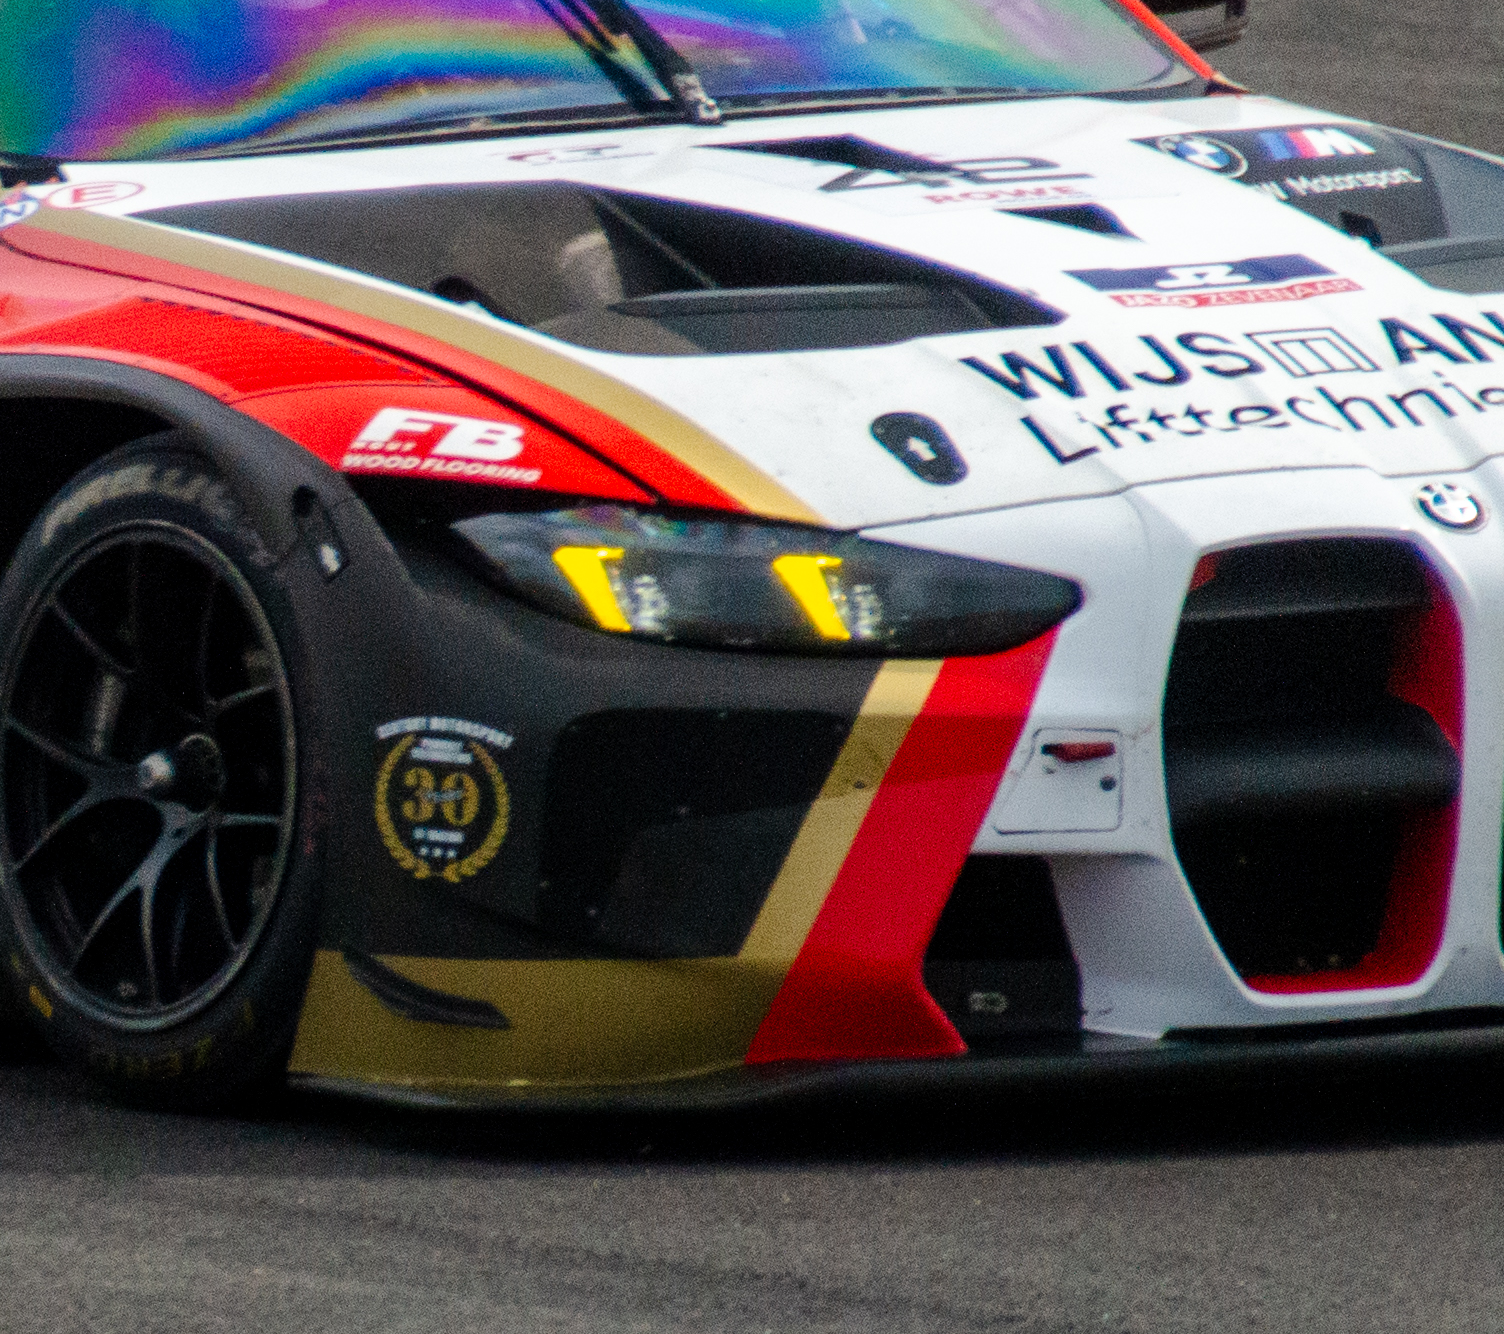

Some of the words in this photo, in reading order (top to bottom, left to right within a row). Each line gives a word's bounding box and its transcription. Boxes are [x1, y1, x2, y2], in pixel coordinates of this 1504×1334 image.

[1285, 167, 1423, 198] Motorsport
[350, 406, 525, 462] FB
[341, 454, 421, 471] WOOD
[420, 458, 543, 484] FLOORING
